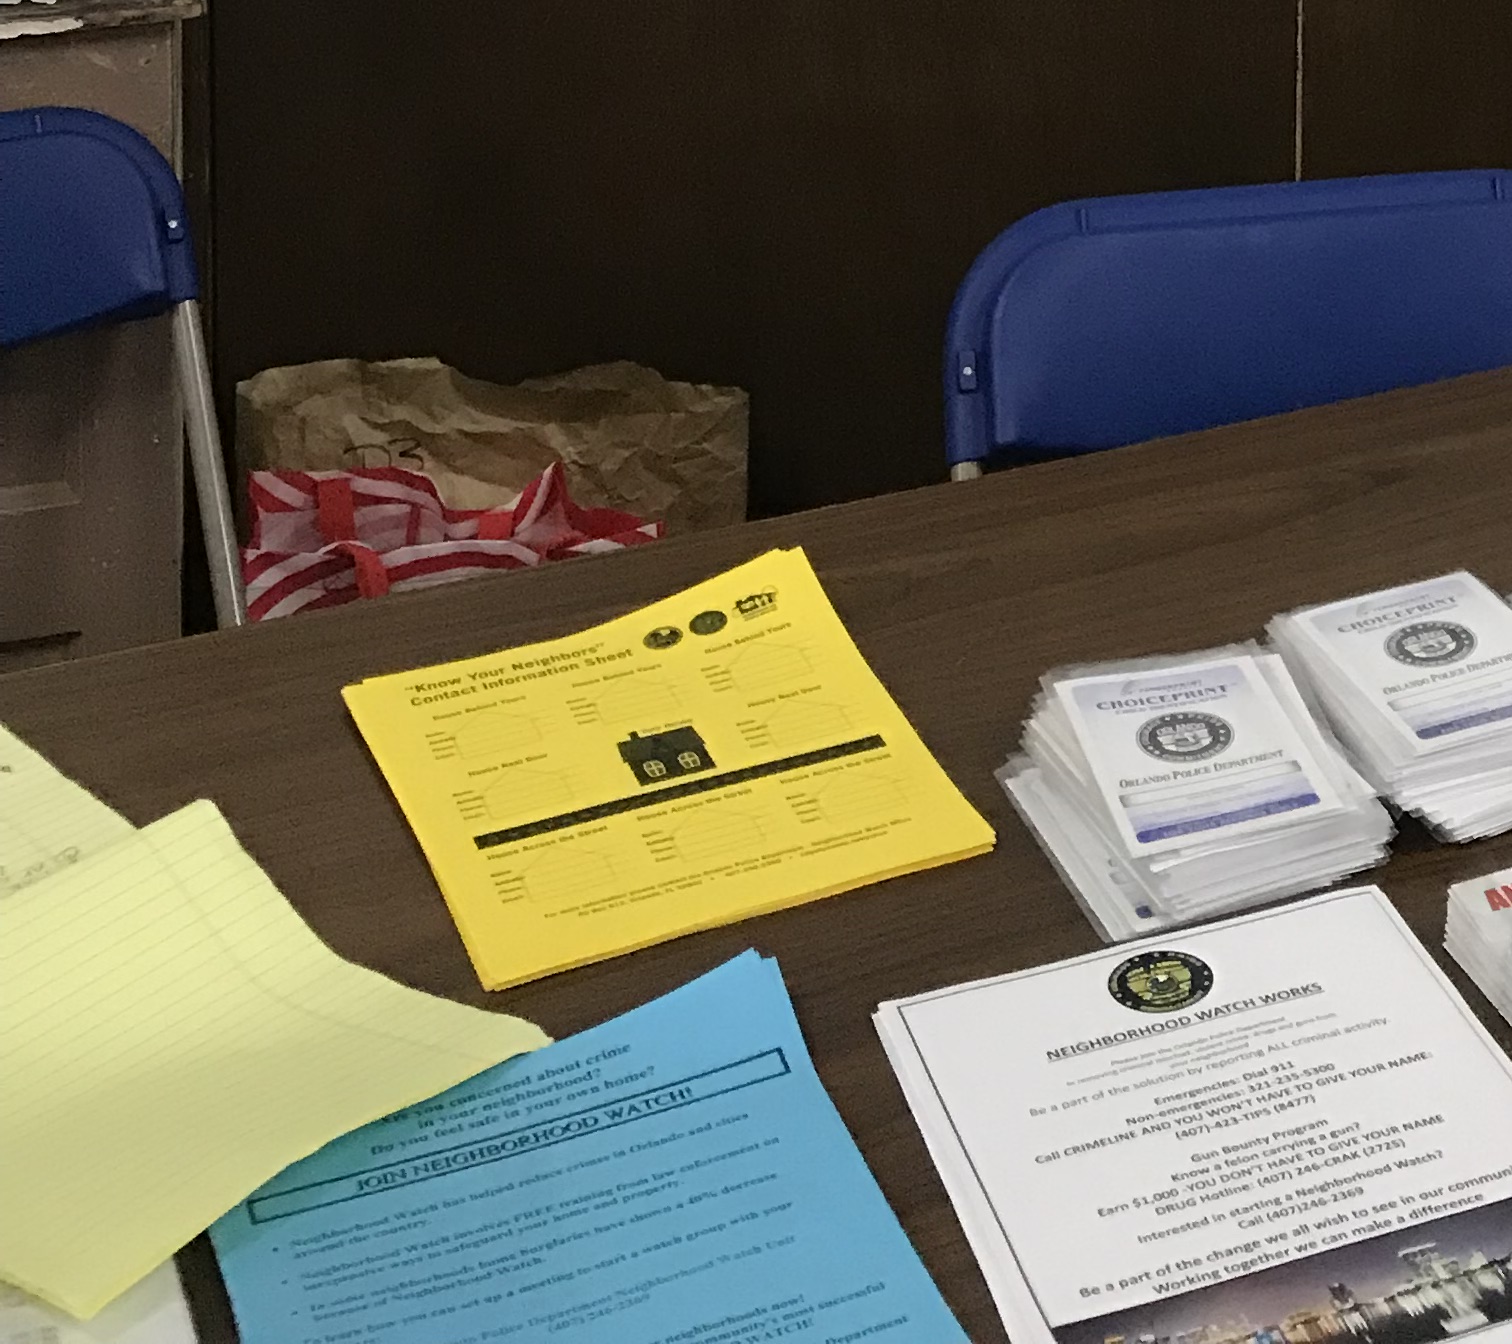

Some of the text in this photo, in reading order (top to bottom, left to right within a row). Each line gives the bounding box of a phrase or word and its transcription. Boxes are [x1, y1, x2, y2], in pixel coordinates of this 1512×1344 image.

[410, 648, 634, 707] Contact Information Sheet
[466, 665, 505, 682] Your
[1046, 982, 1323, 1060] NEIGHBORHOOD WATCH WORKS
[1242, 1068, 1268, 1082] Dial
[1271, 1060, 1294, 1073] 911
[1034, 1150, 1061, 1164] Call
[1063, 1129, 1138, 1157] CRIMELINE
[1141, 1121, 1172, 1136] AND
[1174, 1112, 1203, 1126] YOU
[1256, 1087, 1291, 1104] HAVE
[1293, 1082, 1313, 1094] TO
[1315, 1073, 1348, 1087] GIVE
[1348, 1063, 1386, 1078] YOUR
[1191, 1118, 1329, 1163] Gun Bounty Program
[356, 1162, 408, 1192] JOIN
[413, 1115, 599, 1177] NEIGHBORHOOD
[1097, 1202, 1130, 1217] Earn
[1132, 1187, 1180, 1209] $1,000
[1267, 1153, 1304, 1170] HAVE
[1307, 1146, 1325, 1159] TO
[1327, 1137, 1361, 1152] GIVE
[1361, 1125, 1401, 1142] YOUR
[1402, 1114, 1445, 1132] NAME
[1170, 1122, 1361, 1182] Know a felon carrying a gun?
[1137, 1216, 1210, 1244] Interested
[1212, 1210, 1227, 1223] in
[1229, 1195, 1283, 1218] starting
[1285, 1192, 1293, 1201] a
[1295, 1163, 1393, 1197] Neighborhood
[1154, 1197, 1198, 1217] DRUG
[1237, 1215, 1264, 1230] Call
[1079, 1285, 1101, 1298] Be
[1105, 1282, 1115, 1292] a
[1118, 1270, 1151, 1290] part
[1155, 1263, 1172, 1276] of
[1175, 1258, 1203, 1271] the
[1206, 1239, 1262, 1263] change
[1264, 1230, 1289, 1244] we
[1292, 1224, 1311, 1237] all
[1313, 1212, 1350, 1231] wish
[1352, 1208, 1369, 1220] to
[1372, 1199, 1398, 1213] see
[1400, 1195, 1416, 1206] in
[1419, 1187, 1445, 1201] our
[1152, 1192, 1485, 1295] Working together we can make a difference
